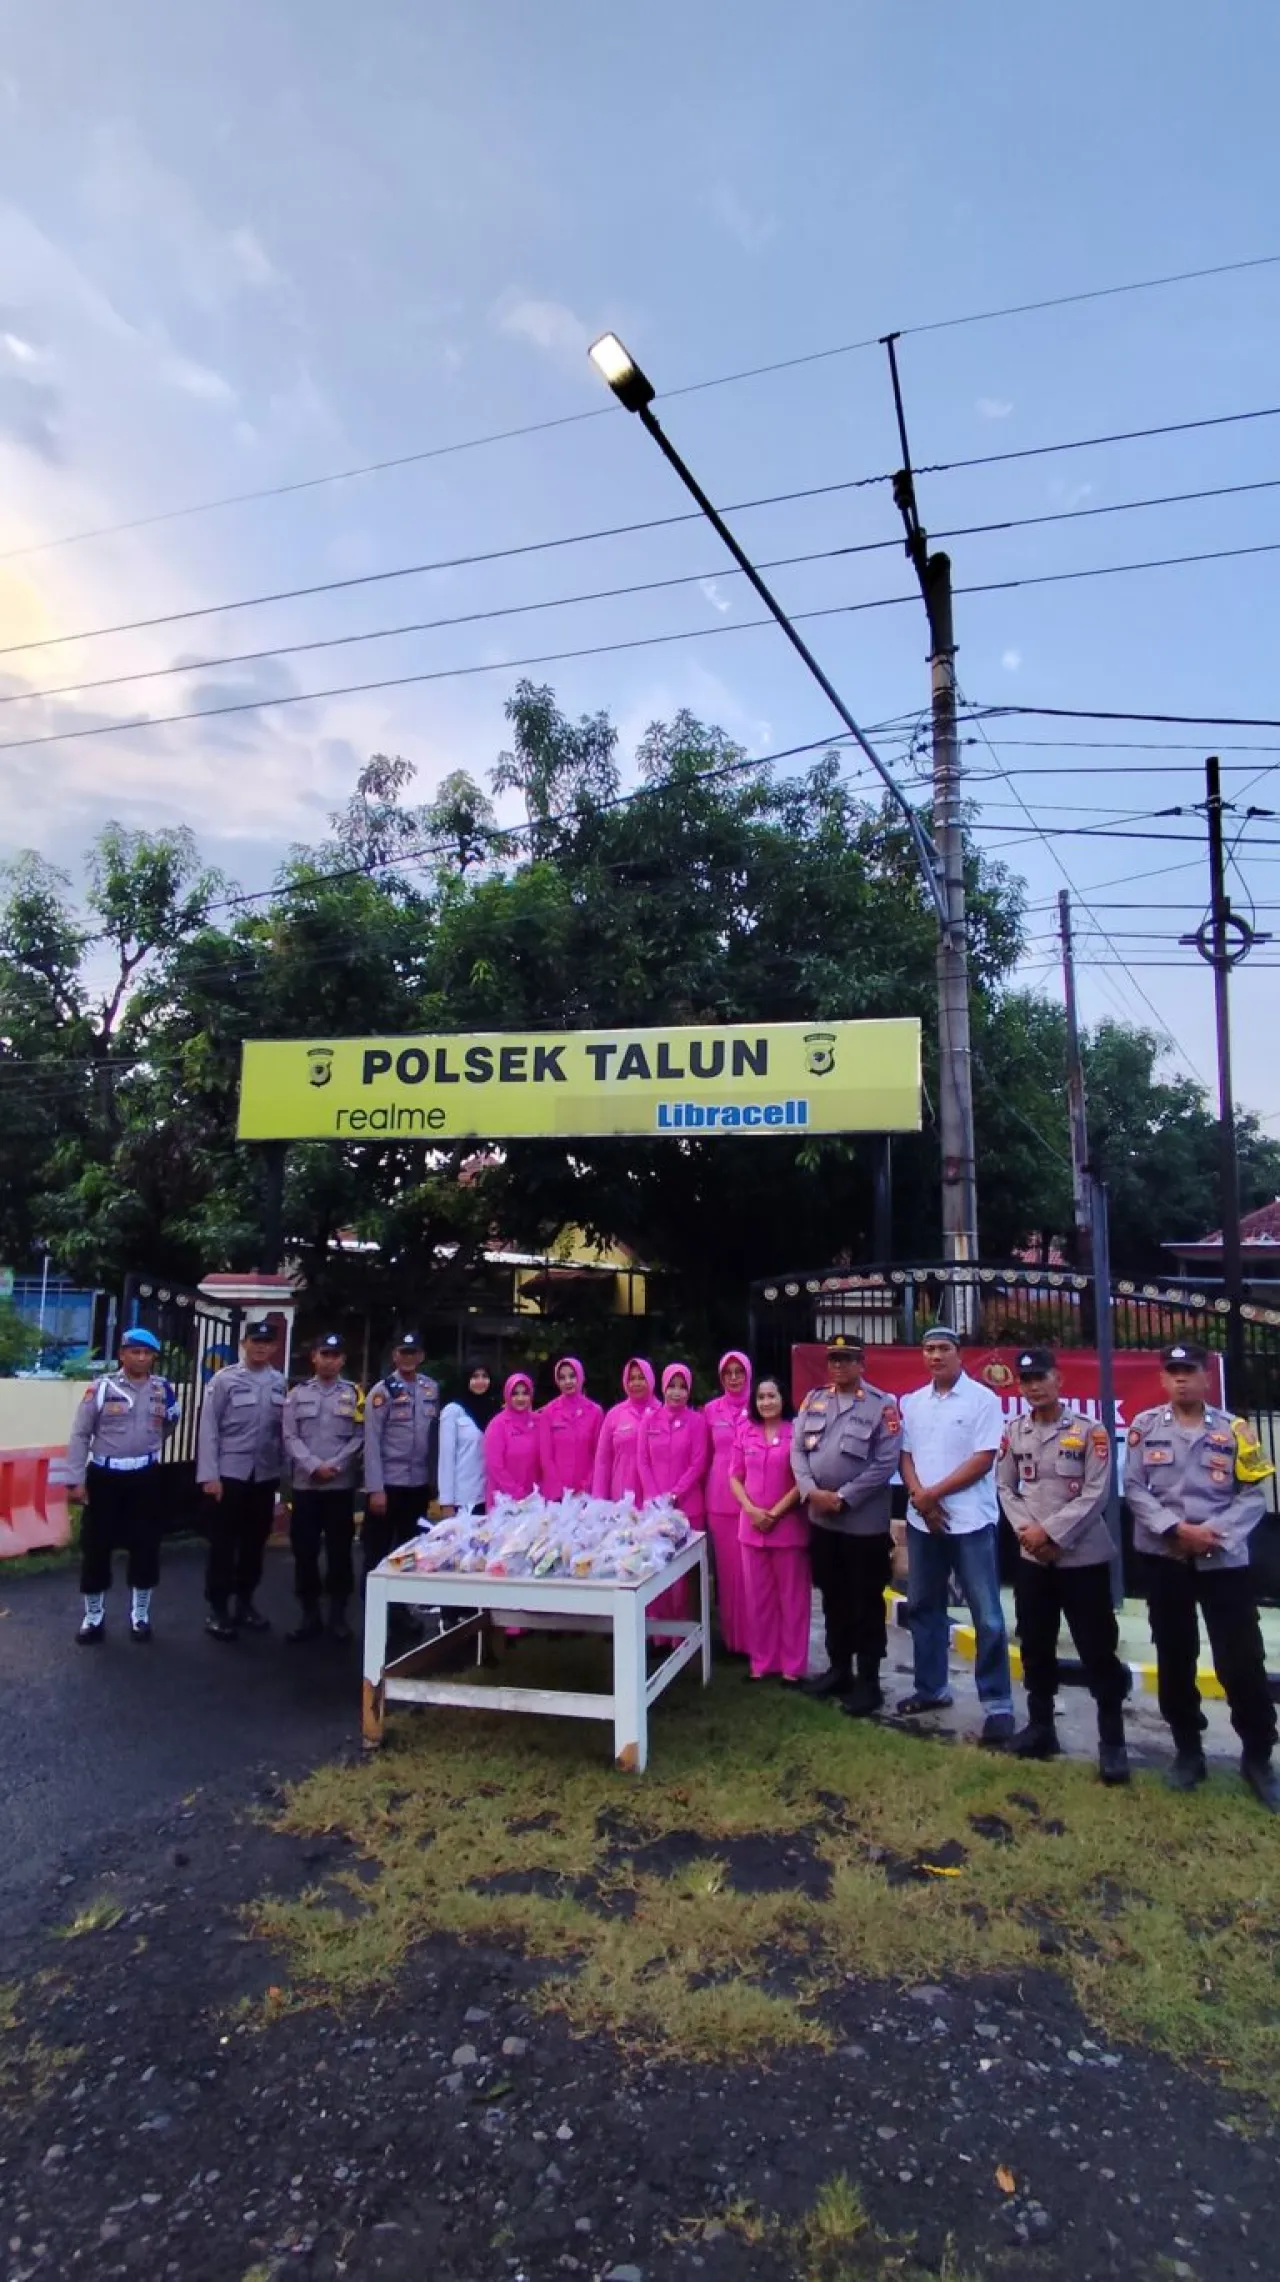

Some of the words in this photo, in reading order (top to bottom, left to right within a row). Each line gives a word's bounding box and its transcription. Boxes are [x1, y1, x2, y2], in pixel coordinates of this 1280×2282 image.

[362, 1045, 567, 1085] POLSEK
[585, 1038, 768, 1081] TALUN
[336, 1103, 446, 1130] realme
[657, 1099, 809, 1128] Libracell
